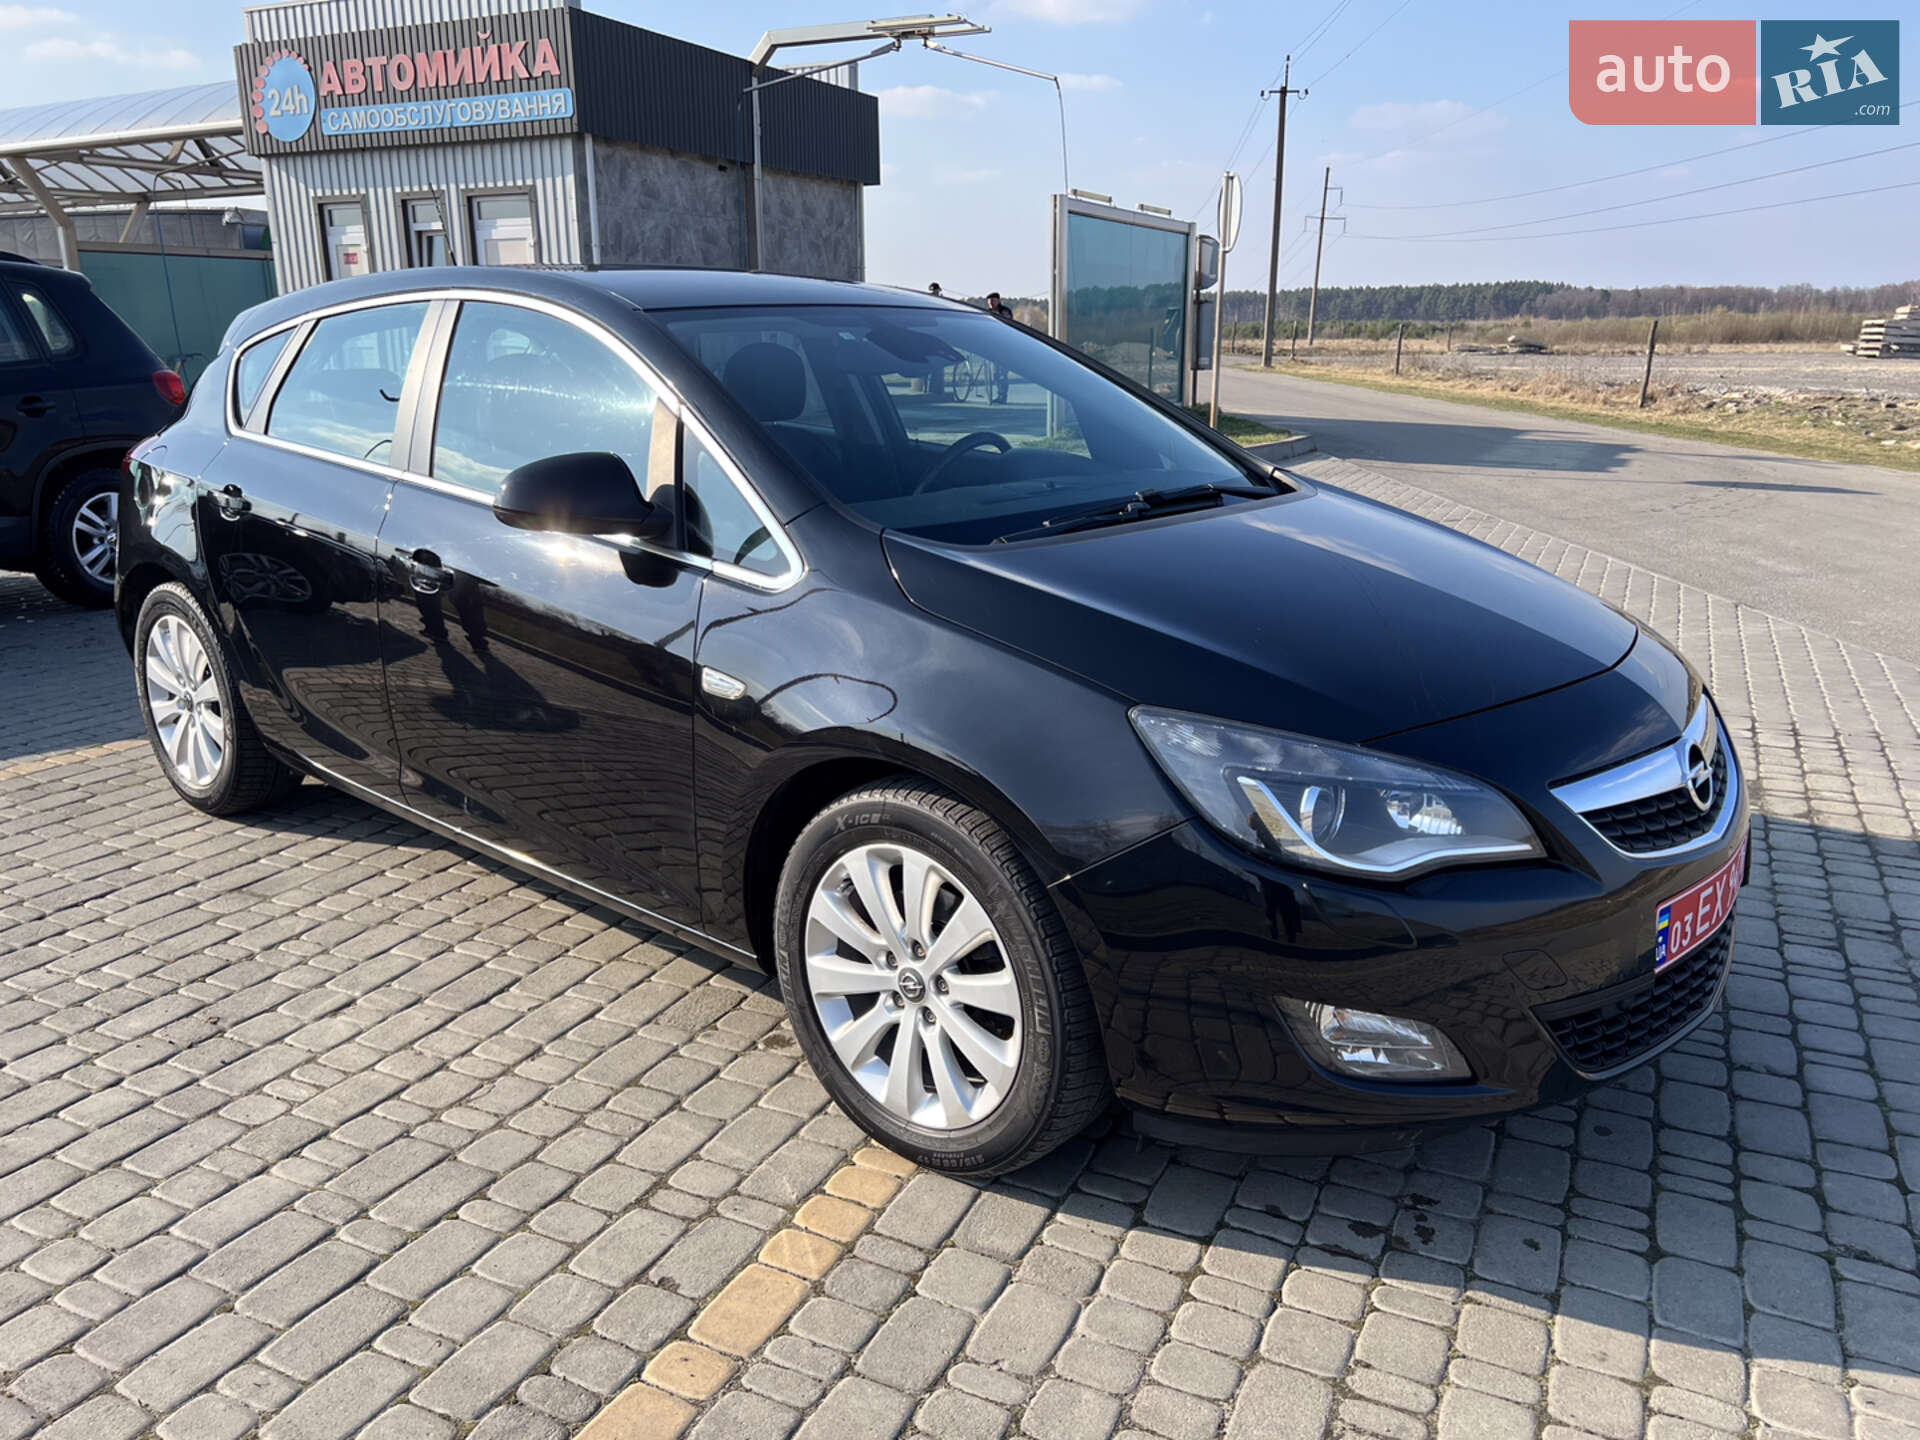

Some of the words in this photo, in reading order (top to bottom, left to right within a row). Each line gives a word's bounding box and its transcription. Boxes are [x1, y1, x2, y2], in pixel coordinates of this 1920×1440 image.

[320, 29, 561, 97] АВТОМИЙКА
[268, 86, 310, 117] 24h
[327, 93, 567, 132] САМООБСЛУГОВУВАННЯ
